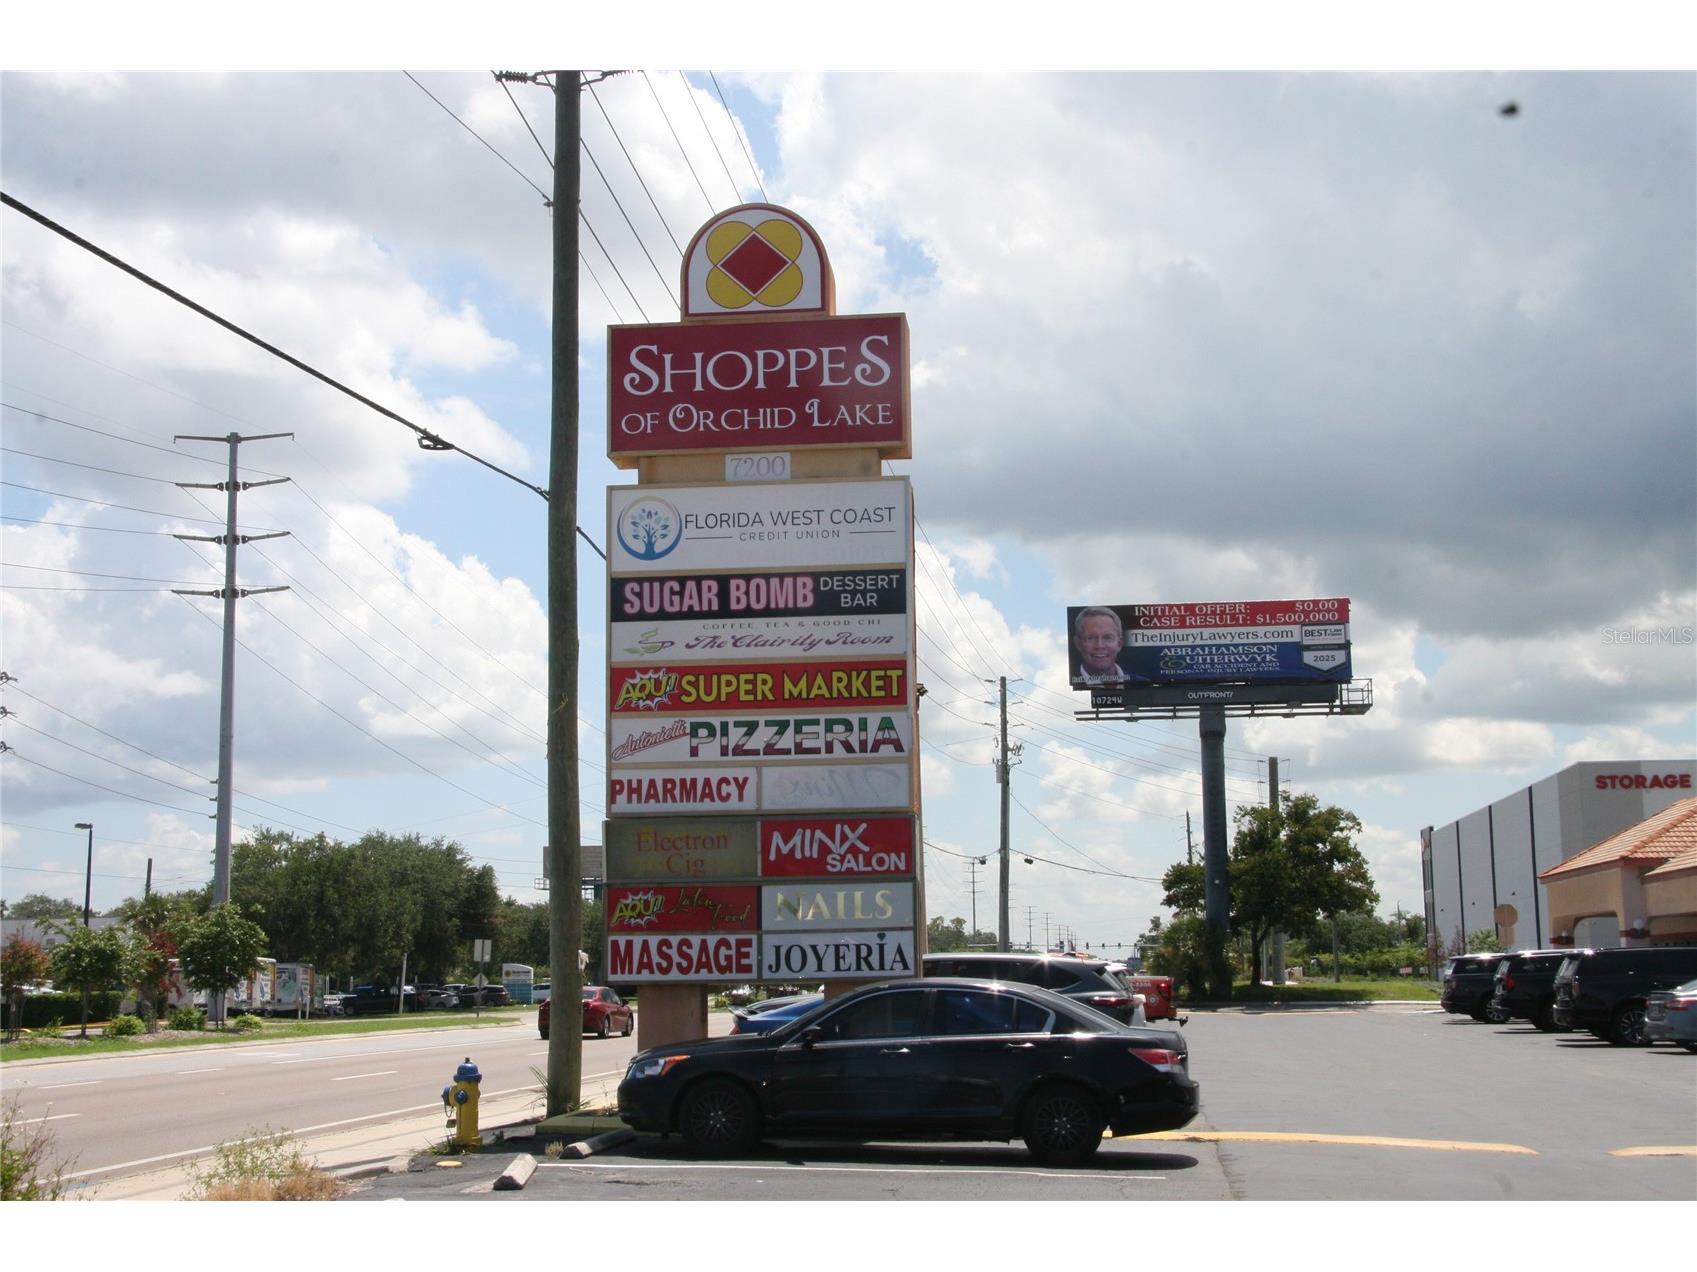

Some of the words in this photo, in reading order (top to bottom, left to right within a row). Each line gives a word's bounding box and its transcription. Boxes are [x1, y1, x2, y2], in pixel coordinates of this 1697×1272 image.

[623, 335, 891, 395] SHOPPES
[668, 403, 796, 433] ORCHID
[805, 399, 894, 427] LAKE
[730, 456, 786, 478] 7200
[684, 511, 764, 529] FLORIDA
[770, 509, 825, 526] WEST
[830, 507, 896, 525] COAST
[739, 532, 788, 542] CREDIT
[795, 530, 840, 539] UNION
[820, 575, 900, 591] DESSERT
[623, 579, 719, 614] SUGAR
[729, 576, 814, 610] BOMB
[840, 593, 878, 608] BAR
[1134, 605, 1189, 616] INITIAL
[1195, 603, 1250, 615] OFFER:
[1295, 600, 1338, 612] $0.00
[765, 621, 790, 629] TEA
[813, 619, 850, 627] GOOD
[1140, 616, 1181, 627] CASE
[1185, 614, 1251, 626] RESULT:
[1256, 611, 1339, 624] $1,500,000
[685, 634, 727, 650] The
[825, 631, 894, 646] Room
[1132, 629, 1294, 645] TheInjuryLawyers.com
[1304, 629, 1328, 637] BEST
[1160, 644, 1278, 656] ABRAHAMSON
[1185, 653, 1279, 664] UITERWYK
[1313, 654, 1336, 662] 2025
[680, 672, 774, 703] SUPER
[783, 669, 903, 700] MARKET
[689, 716, 905, 758] PIZZERIA
[610, 776, 750, 805] PHARMACY
[1595, 773, 1692, 790] STORAGE
[635, 831, 729, 853] Electron
[769, 823, 870, 862] MINX
[666, 853, 705, 878] Cig
[826, 852, 906, 873] SALON
[774, 890, 894, 922] NAILS
[610, 938, 754, 976] MASSAGE
